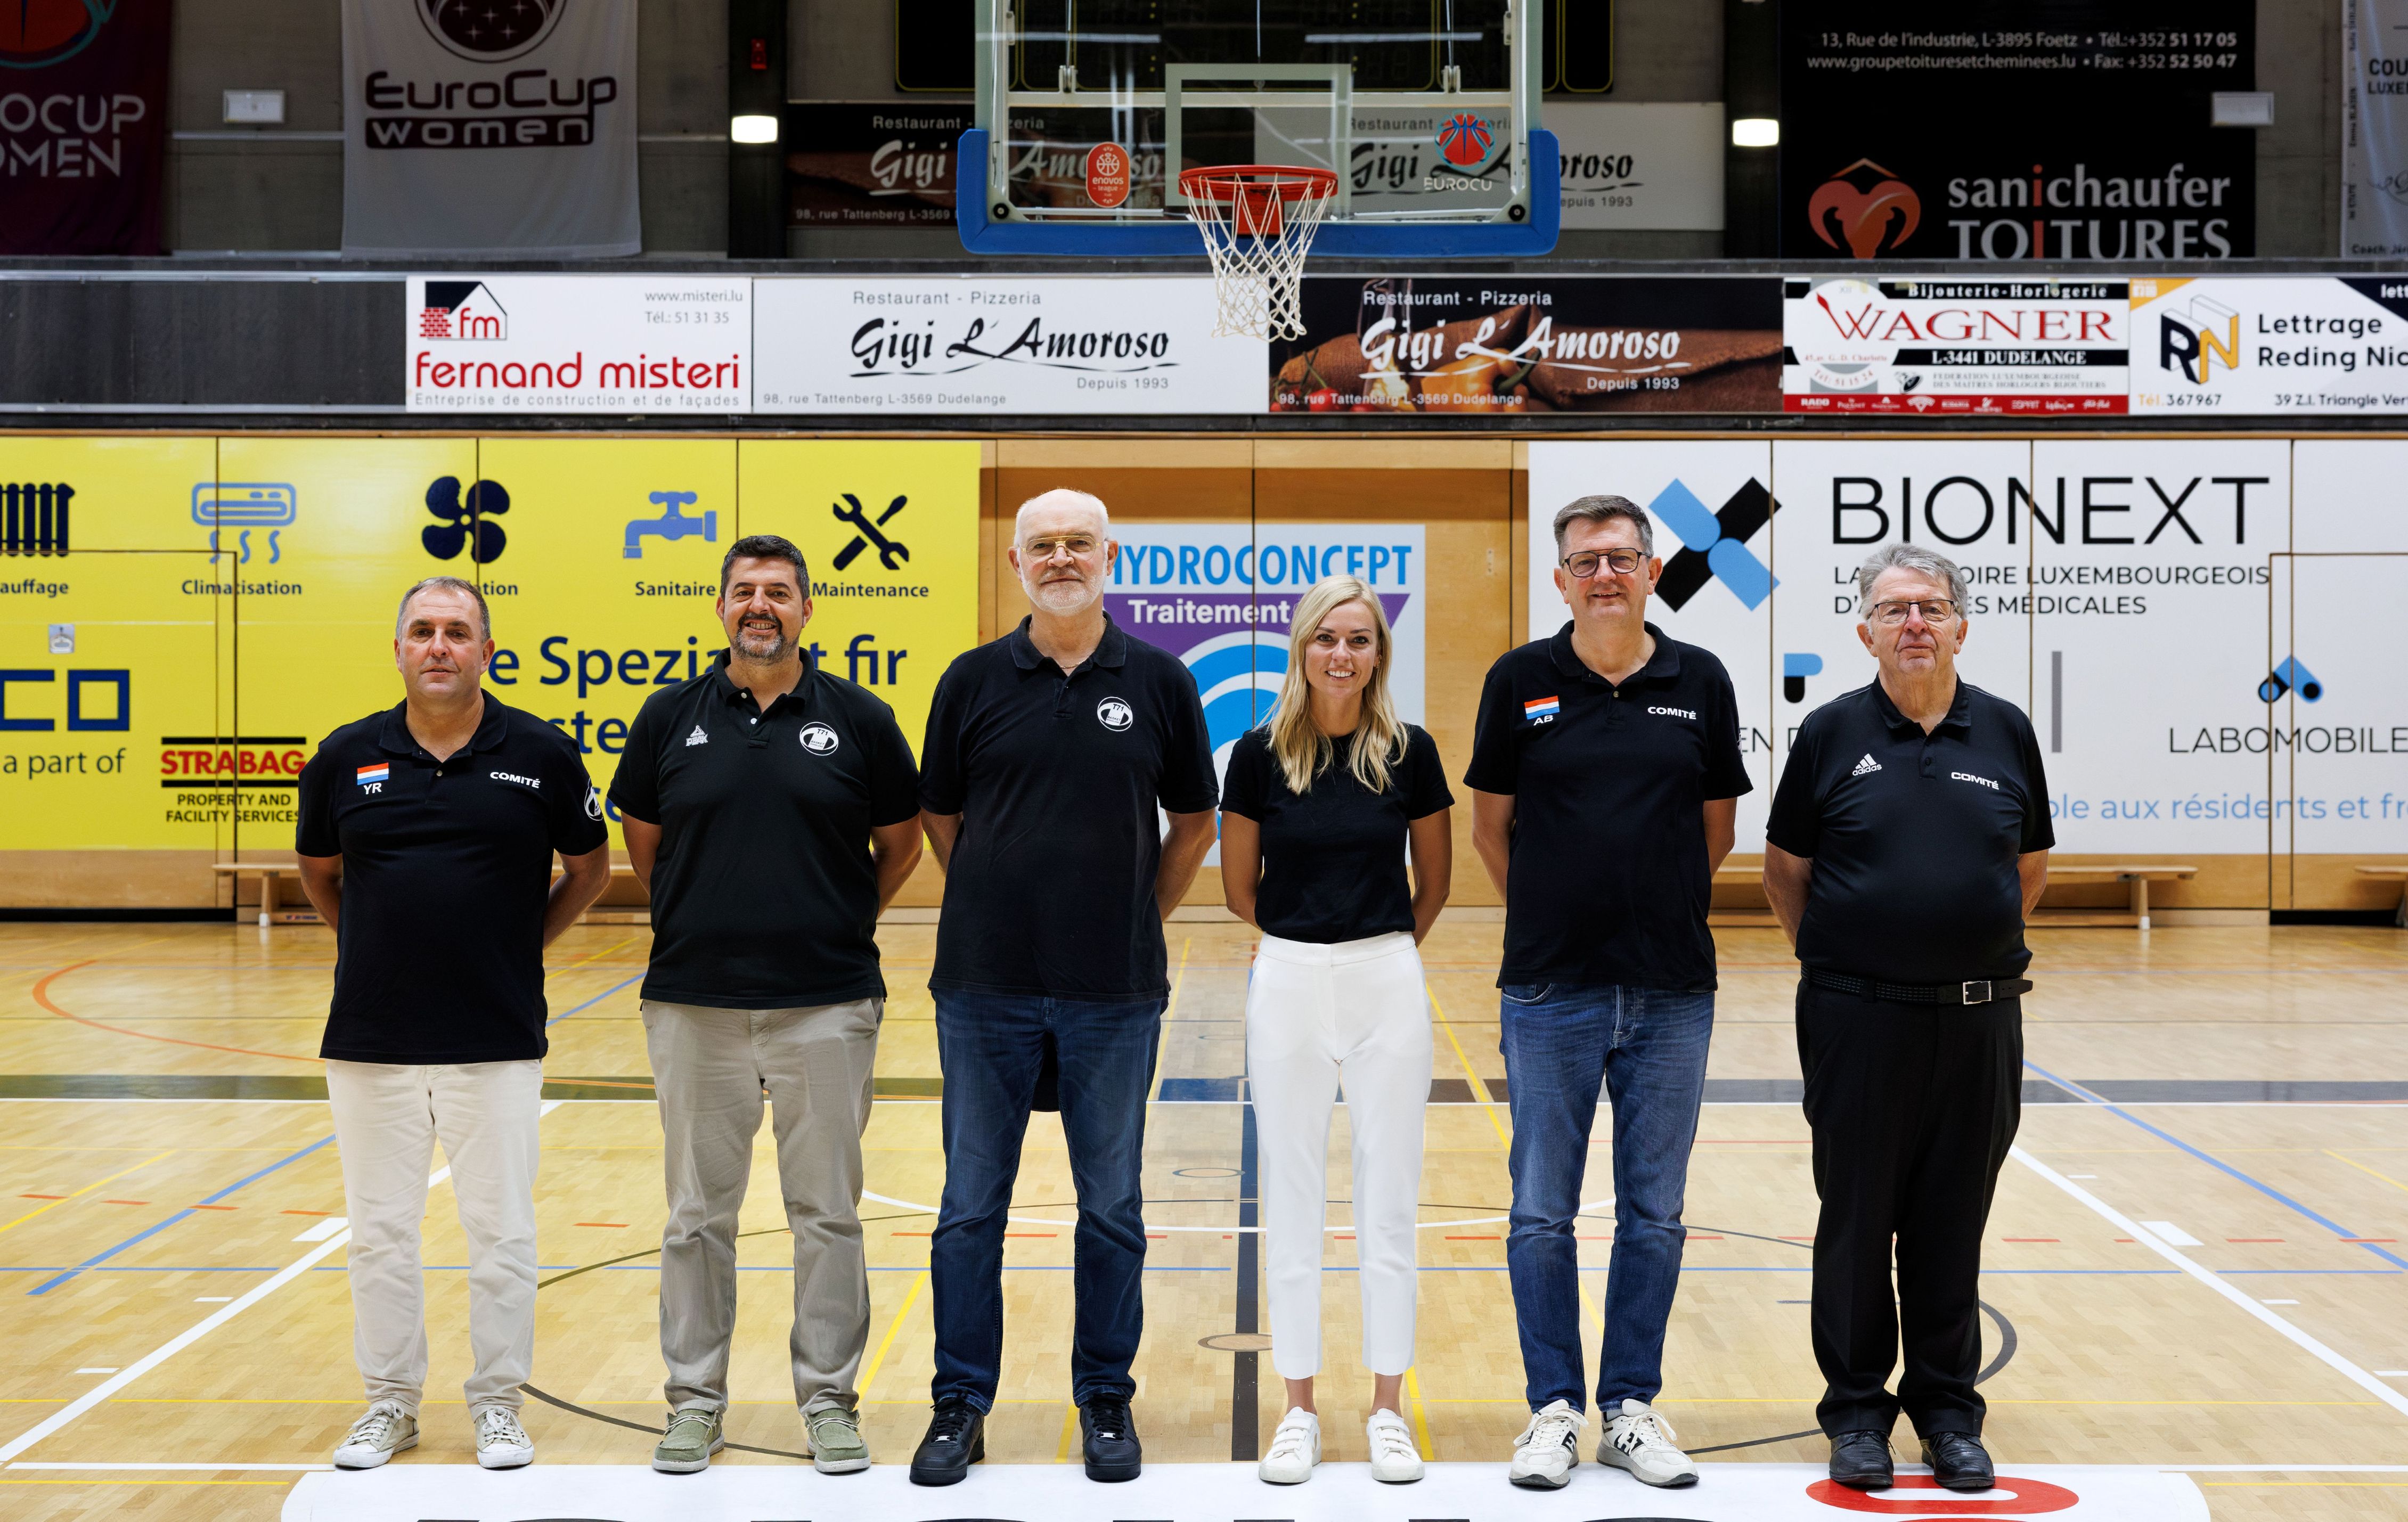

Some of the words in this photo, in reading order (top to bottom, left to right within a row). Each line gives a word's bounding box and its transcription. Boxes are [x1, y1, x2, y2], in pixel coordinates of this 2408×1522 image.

[1821, 31, 1843, 48] 13,
[1846, 32, 1876, 47] Rue
[1878, 31, 1898, 47] de
[1982, 32, 2034, 47] L-3895
[2036, 31, 2078, 47] Foetz
[2169, 32, 2188, 47] 51
[2193, 32, 2214, 47] 17
[2216, 32, 2237, 47] 05
[1807, 53, 2076, 72] www.groupetoituresetcheminees.lu
[2169, 54, 2190, 69] 52
[2192, 54, 2214, 69] 50
[2216, 54, 2237, 69] 47
[2368, 82, 2408, 95] LUXE
[872, 116, 961, 130] Restaurant
[373, 119, 589, 145] women
[0, 137, 121, 178] MEN
[870, 138, 948, 188] Gigi
[1948, 162, 2232, 208] sanichaufer
[1602, 197, 1634, 207] 1993
[1948, 218, 2232, 258] TOITURES
[645, 290, 744, 302] www.misteri.lu
[853, 291, 950, 305] Restaurant
[970, 291, 1042, 305] Pizzeria
[1364, 291, 1460, 306] Restaurant
[1481, 291, 1552, 306] Pizzeria
[675, 312, 689, 324] 51
[695, 312, 709, 324] 31
[715, 312, 730, 324] 35
[1816, 292, 2117, 341] WAGNER
[2259, 313, 2382, 339] Lettrage
[852, 317, 935, 369] Gigi
[1360, 317, 1446, 370] Gigi
[1932, 350, 1979, 365] L-3441
[1985, 350, 2086, 365] DUDELANGE
[2259, 347, 2356, 371] Reding
[415, 351, 582, 388] fernand
[600, 353, 739, 389] misteri
[1077, 378, 1127, 390] Depuis
[1134, 378, 1170, 389] 1993
[1587, 378, 1638, 392] Depuis
[1645, 378, 1680, 390] 1993
[415, 394, 495, 408] Entreprise
[502, 394, 520, 406] de
[528, 394, 626, 406] construction
[633, 395, 648, 406] et
[655, 394, 673, 406] de
[680, 394, 740, 409] façades
[763, 394, 783, 405] 98,
[815, 394, 883, 407] Tattenberg
[888, 394, 933, 404] L-3569
[938, 394, 1007, 407] Dudelange
[1279, 395, 1299, 406] 98,
[1330, 394, 1399, 407] Tattenberg
[1403, 394, 1448, 405] L-3569
[1454, 394, 1523, 407] Dudelange
[2167, 394, 2222, 406] 367967
[2275, 394, 2291, 406] 39
[2319, 393, 2378, 408] Triangle
[1832, 476, 2270, 546] BIONEXT
[2027, 566, 2270, 585] LUXEMBOURGEOIS
[182, 579, 303, 596] Climatisation
[636, 580, 716, 596] Sanitaire
[813, 582, 929, 598] Maintenance
[1128, 598, 1291, 624] Traitement
[1998, 592, 2147, 615] MÉDICALES
[845, 634, 907, 685] fir
[1533, 714, 1554, 726] AB
[1647, 706, 1696, 719] COMITÉ
[2169, 727, 2408, 753] LABOMOBILE
[3, 755, 17, 774] a
[28, 750, 87, 780] part
[96, 748, 127, 774] of
[161, 749, 306, 775] STRABAG
[1852, 764, 1882, 776] adidas
[363, 782, 382, 795] YR
[489, 772, 541, 789] COMITÉ
[1951, 772, 1999, 790] COMITÉ
[177, 793, 253, 806] PROPERTY
[258, 793, 291, 806] AND
[2101, 800, 2159, 819] aux
[2172, 793, 2326, 819] résidents
[2338, 796, 2370, 819] et
[166, 810, 229, 823] FACILITY
